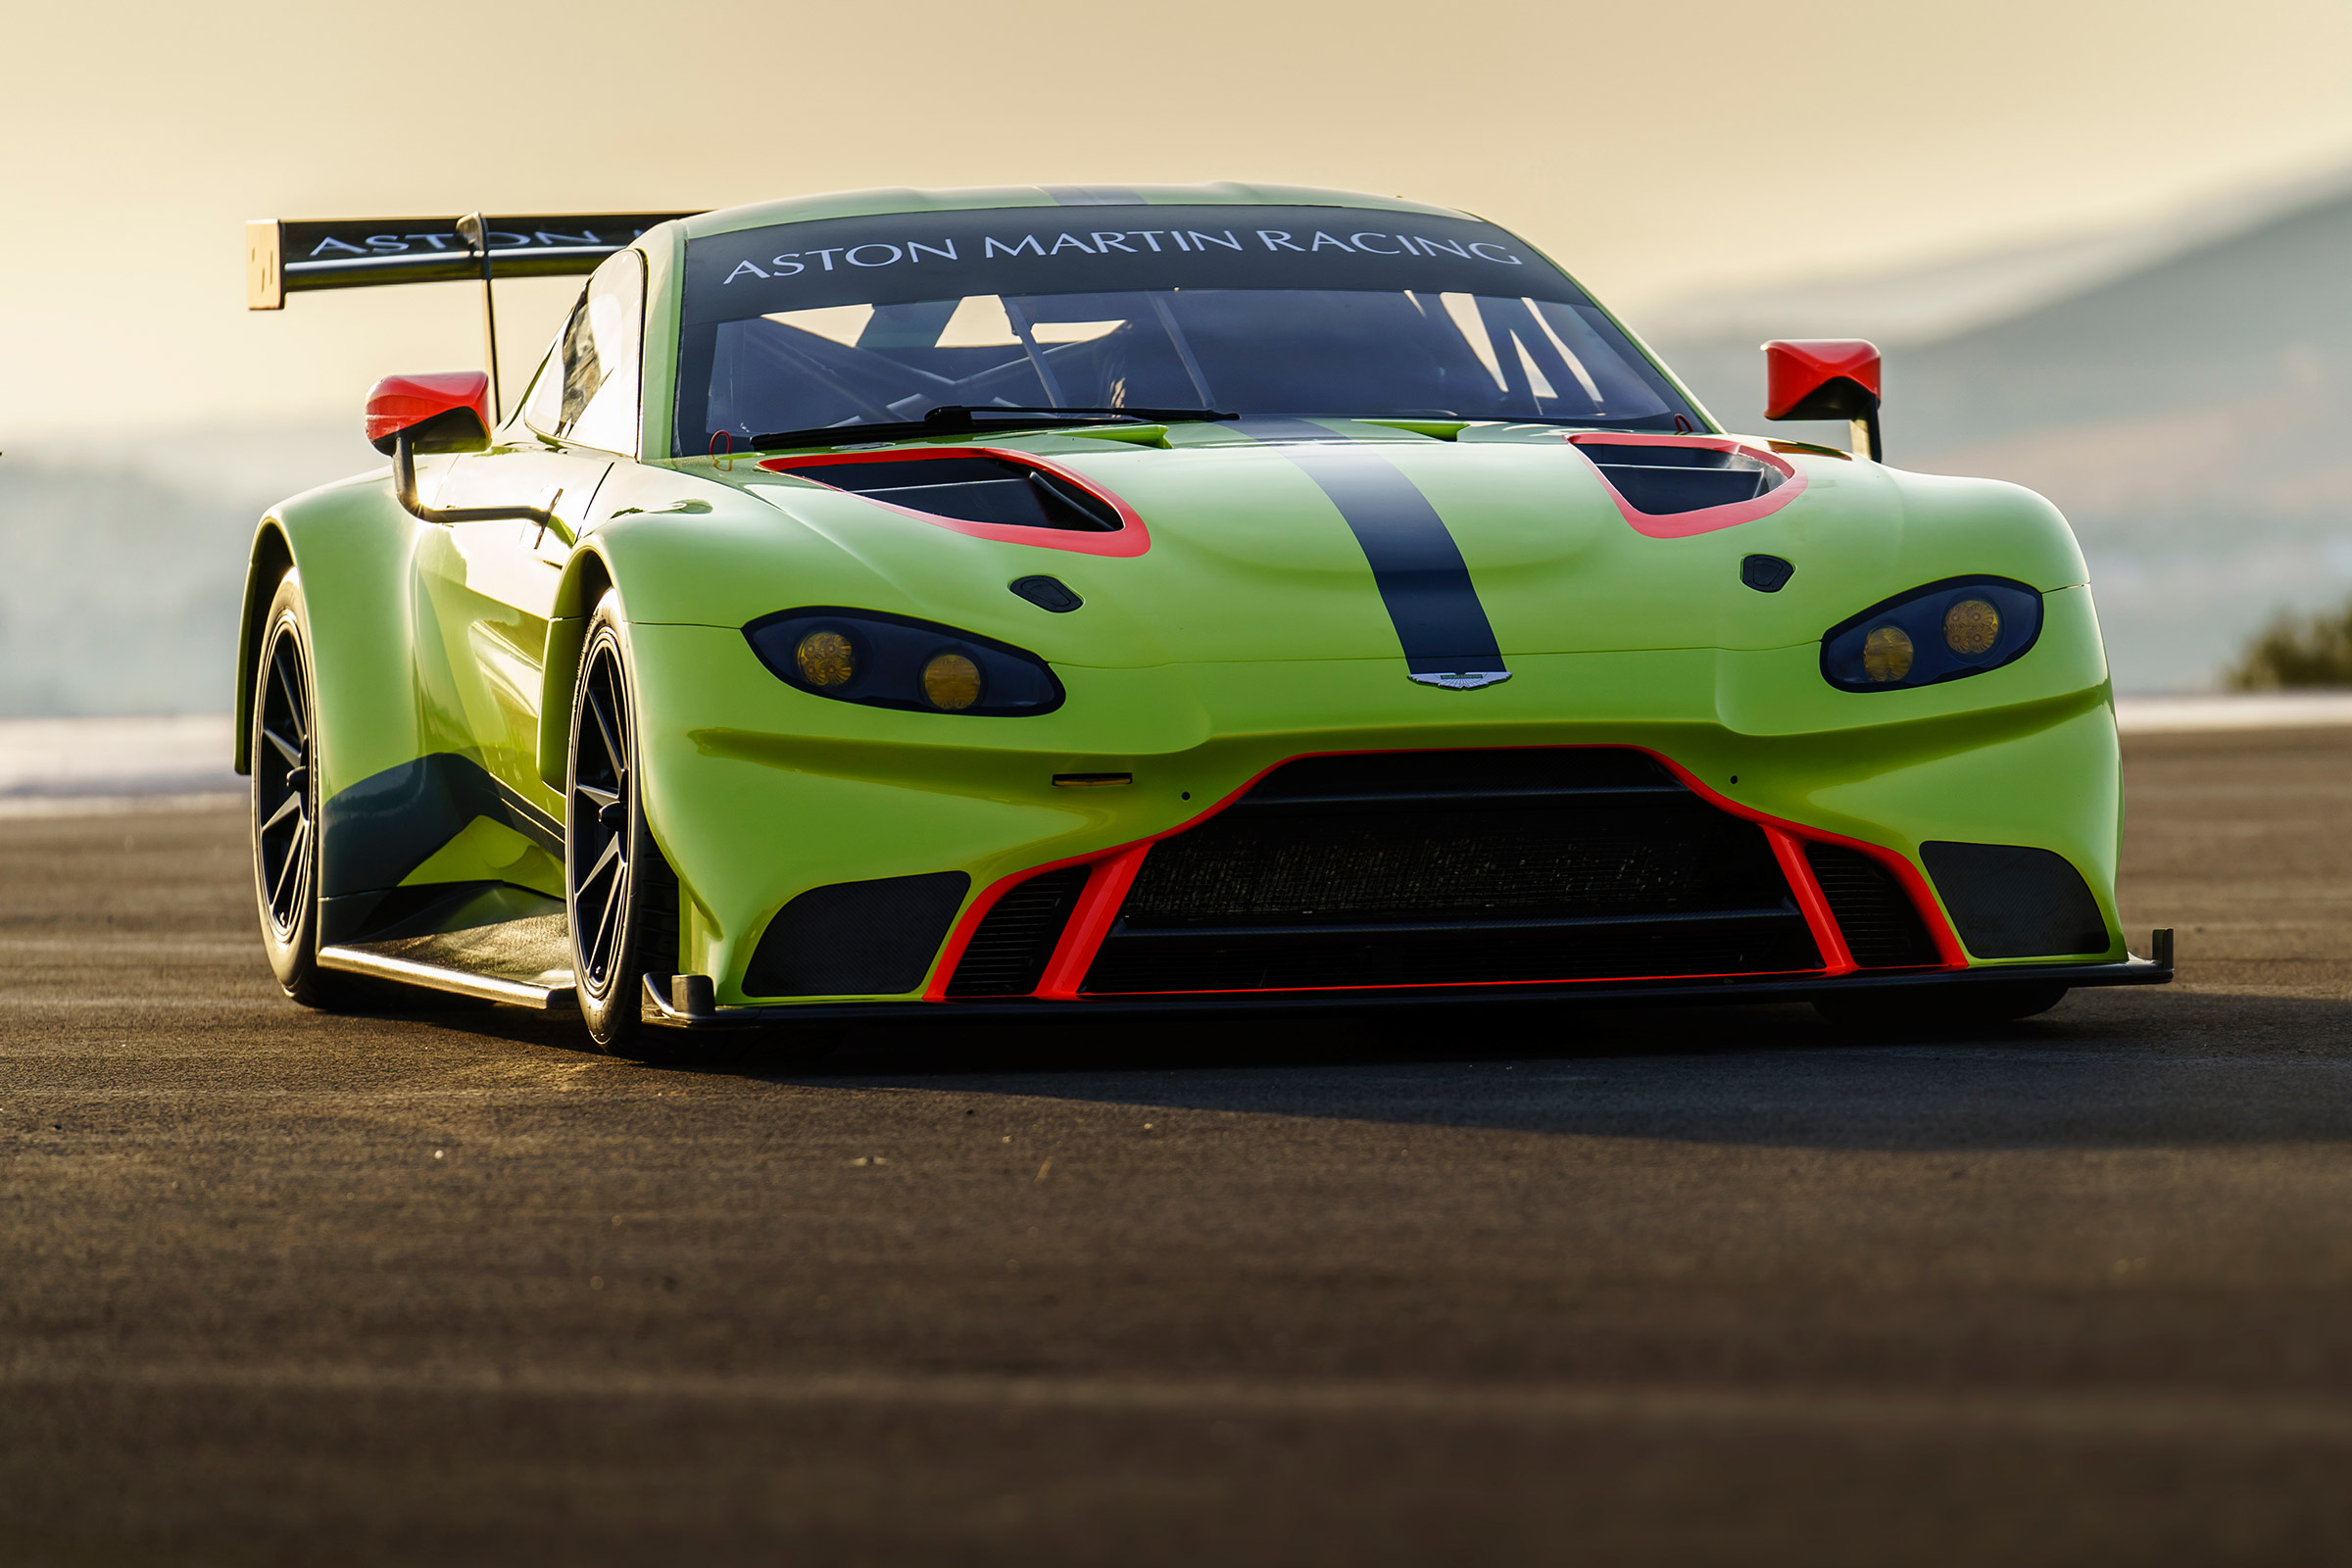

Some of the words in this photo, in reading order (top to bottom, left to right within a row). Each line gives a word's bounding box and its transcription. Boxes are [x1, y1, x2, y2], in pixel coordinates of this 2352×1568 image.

[309, 230, 603, 257] ASTON
[722, 238, 958, 285] ASTON
[984, 229, 1244, 259] MARTIN
[1255, 229, 1523, 266] RACING
